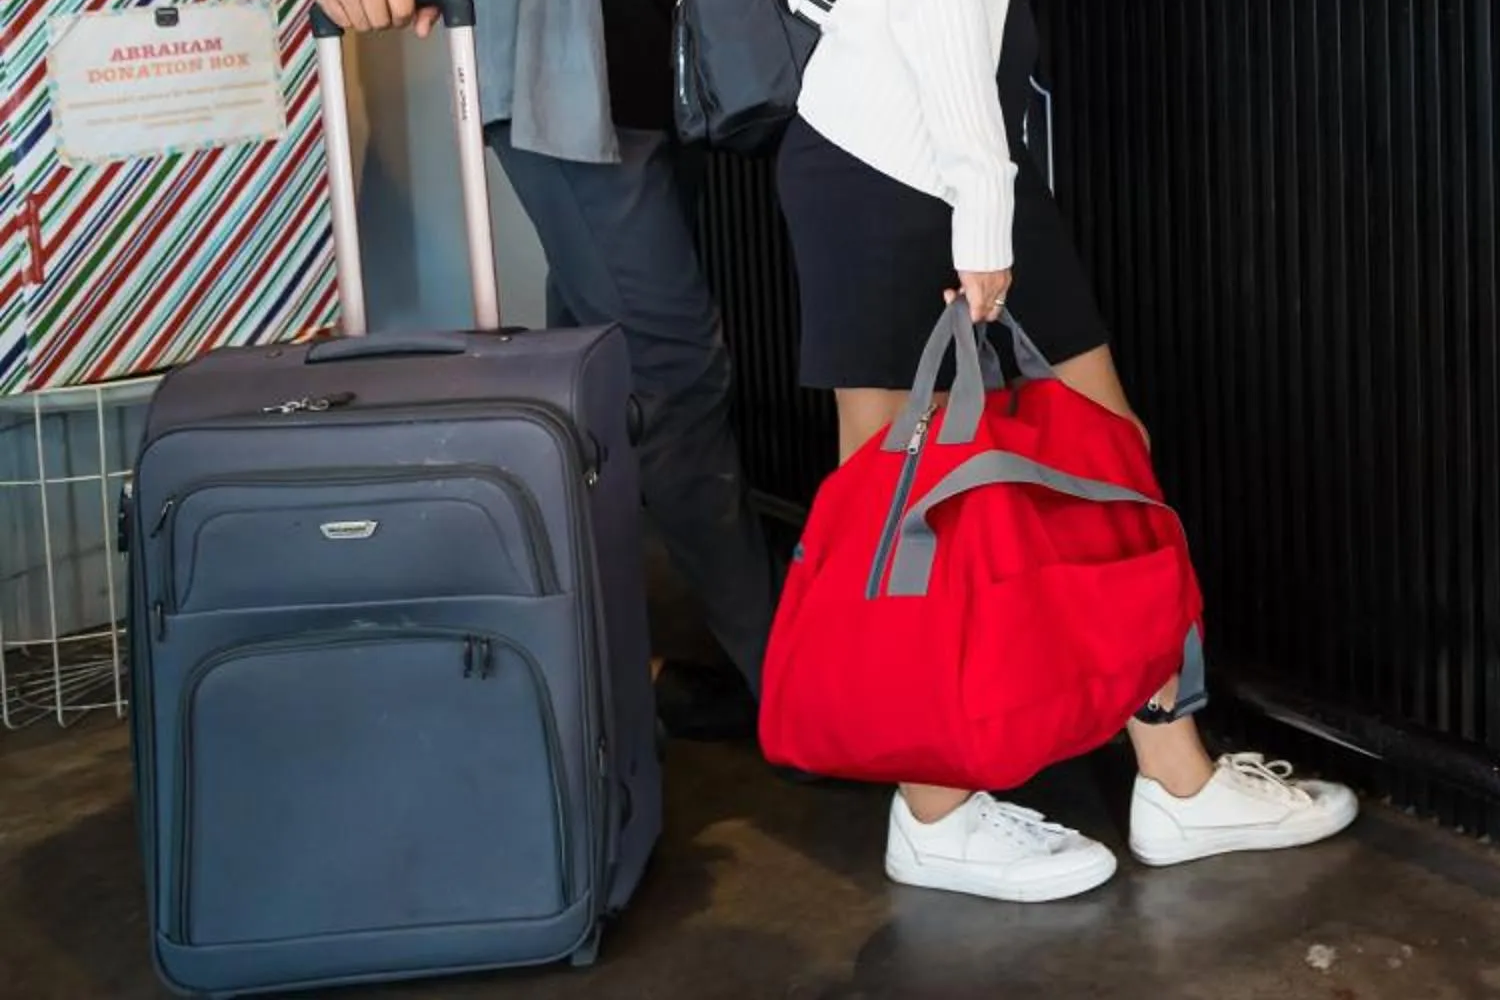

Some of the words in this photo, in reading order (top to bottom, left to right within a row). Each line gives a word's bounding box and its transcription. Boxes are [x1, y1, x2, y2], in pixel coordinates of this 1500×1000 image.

[111, 37, 223, 63] ABRAHAM
[87, 57, 205, 84] DONATION
[210, 53, 250, 71] BOX
